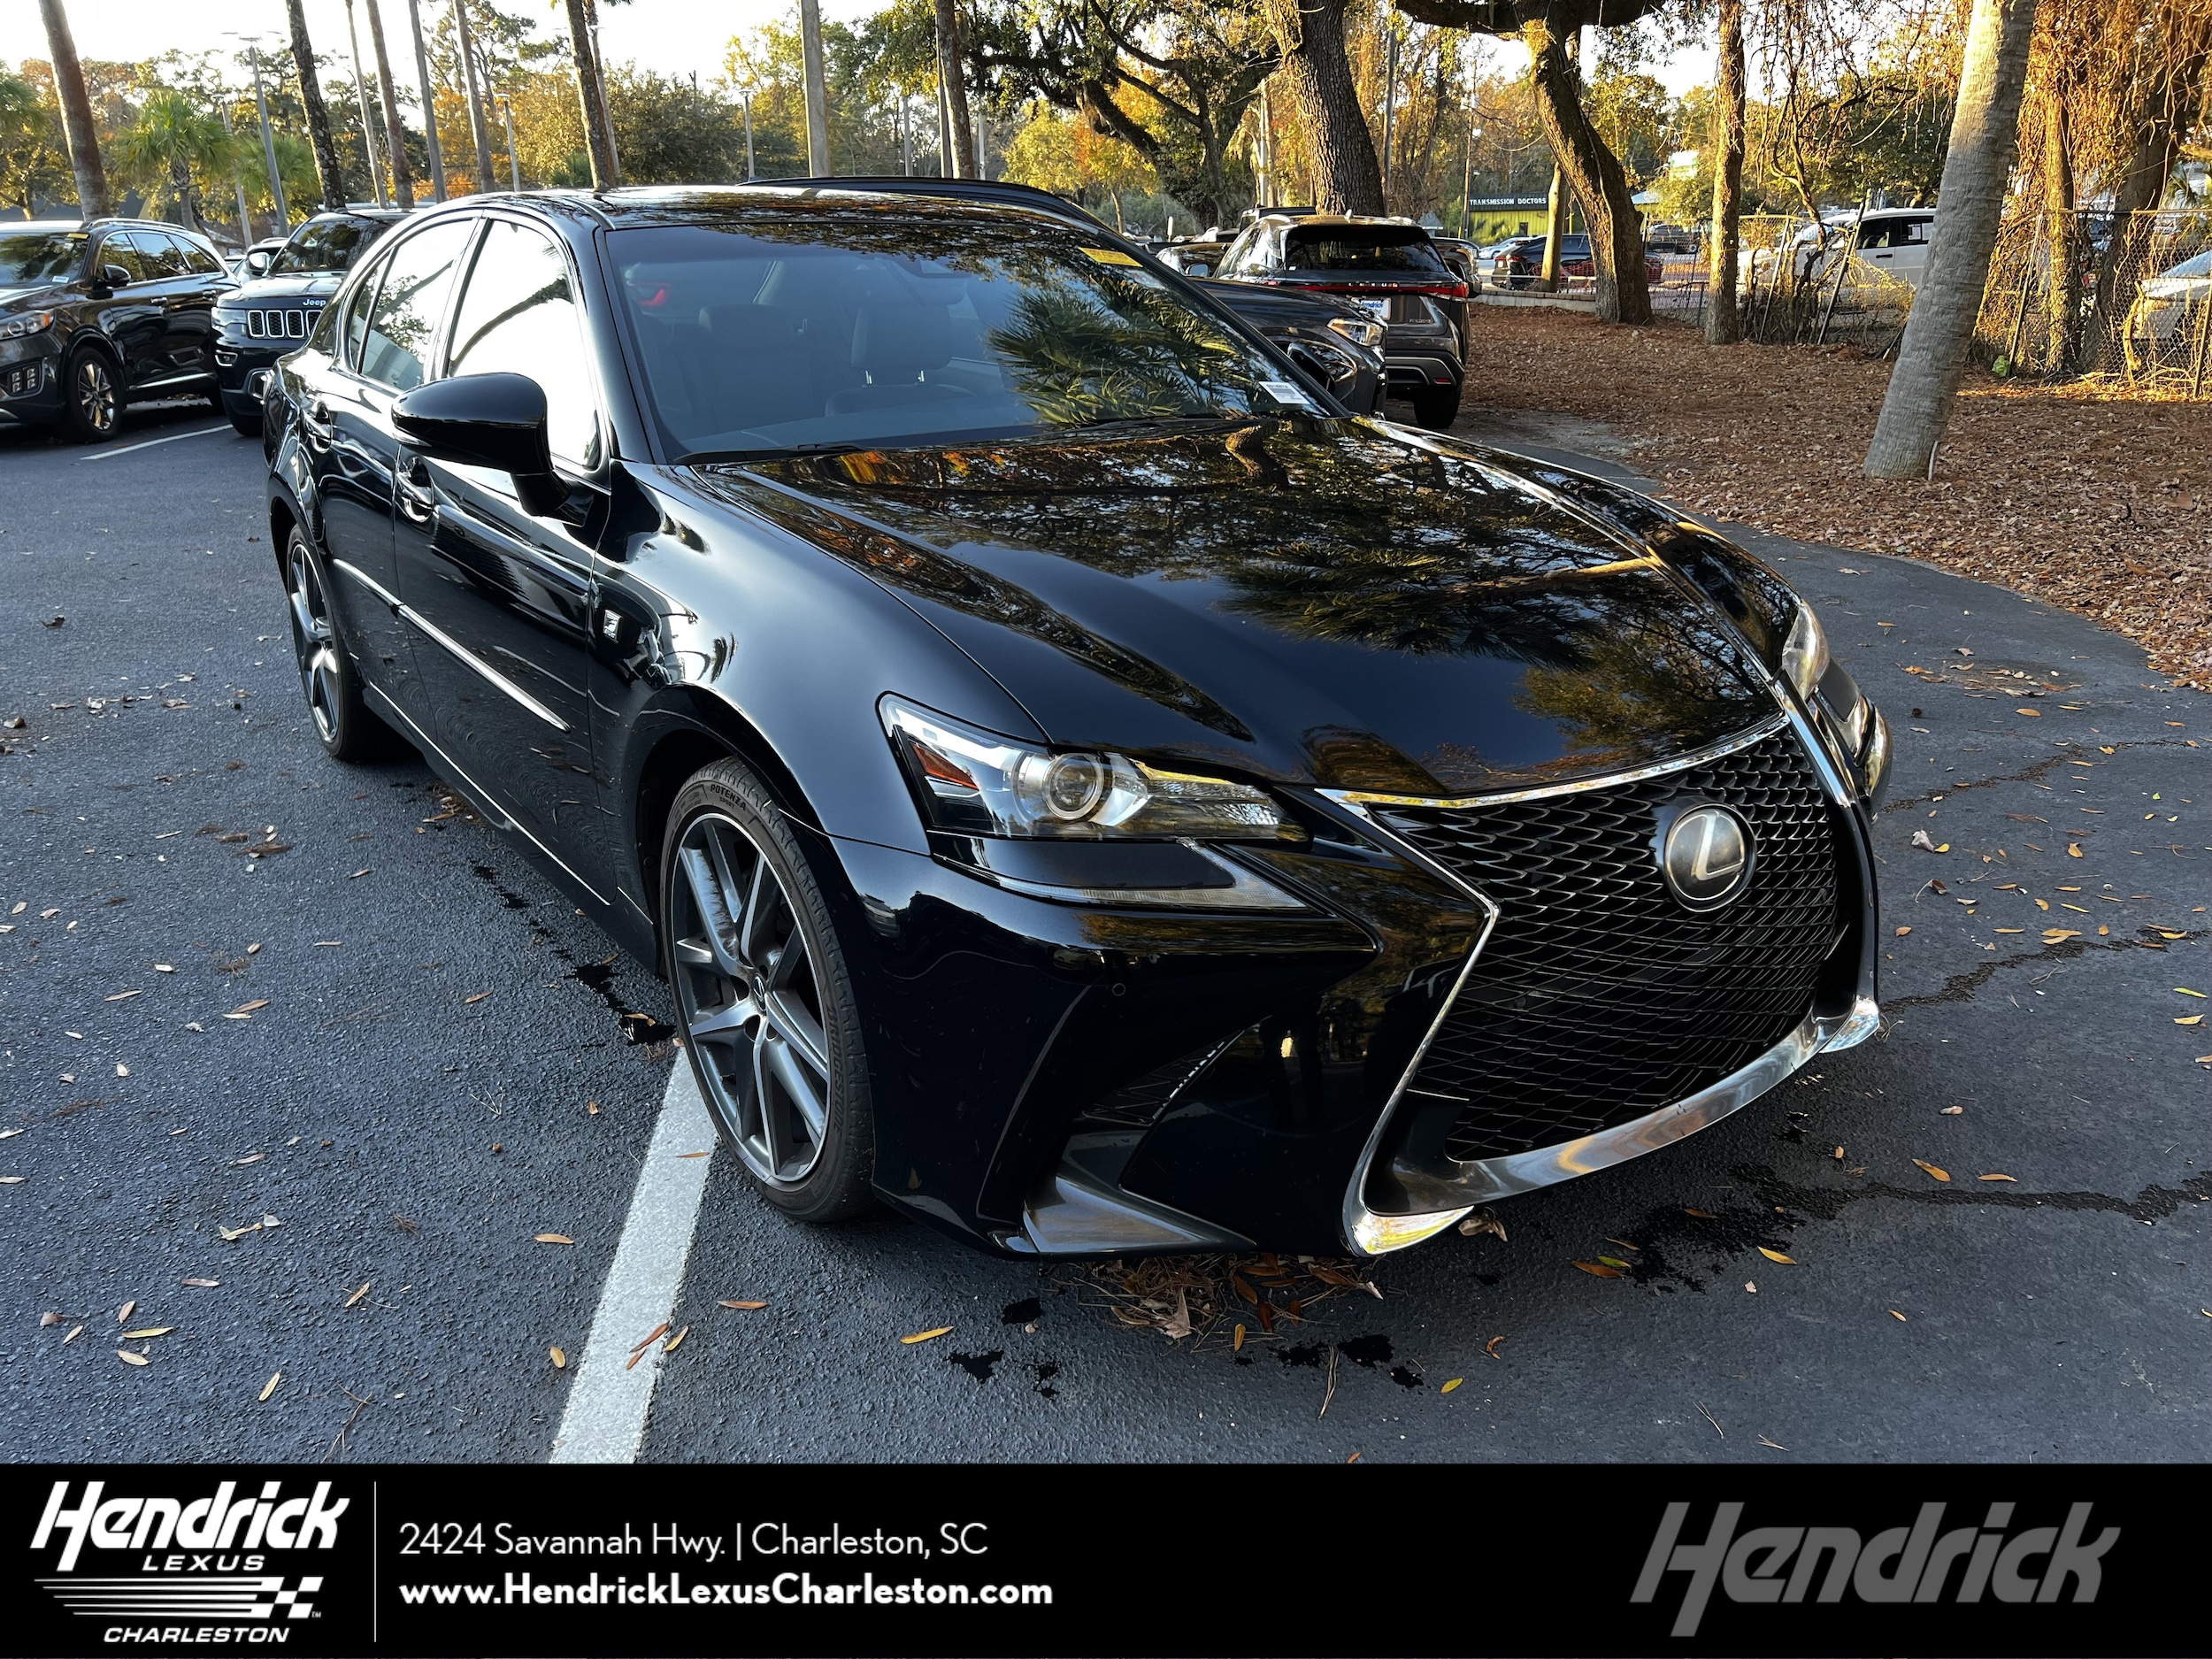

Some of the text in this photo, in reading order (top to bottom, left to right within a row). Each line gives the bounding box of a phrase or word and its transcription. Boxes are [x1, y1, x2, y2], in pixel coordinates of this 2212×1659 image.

[303, 298, 326, 307] Jeep
[710, 784, 747, 811] POTENZA
[719, 796, 736, 810] SPORT
[826, 1003, 845, 1137] BRIDGESTONE
